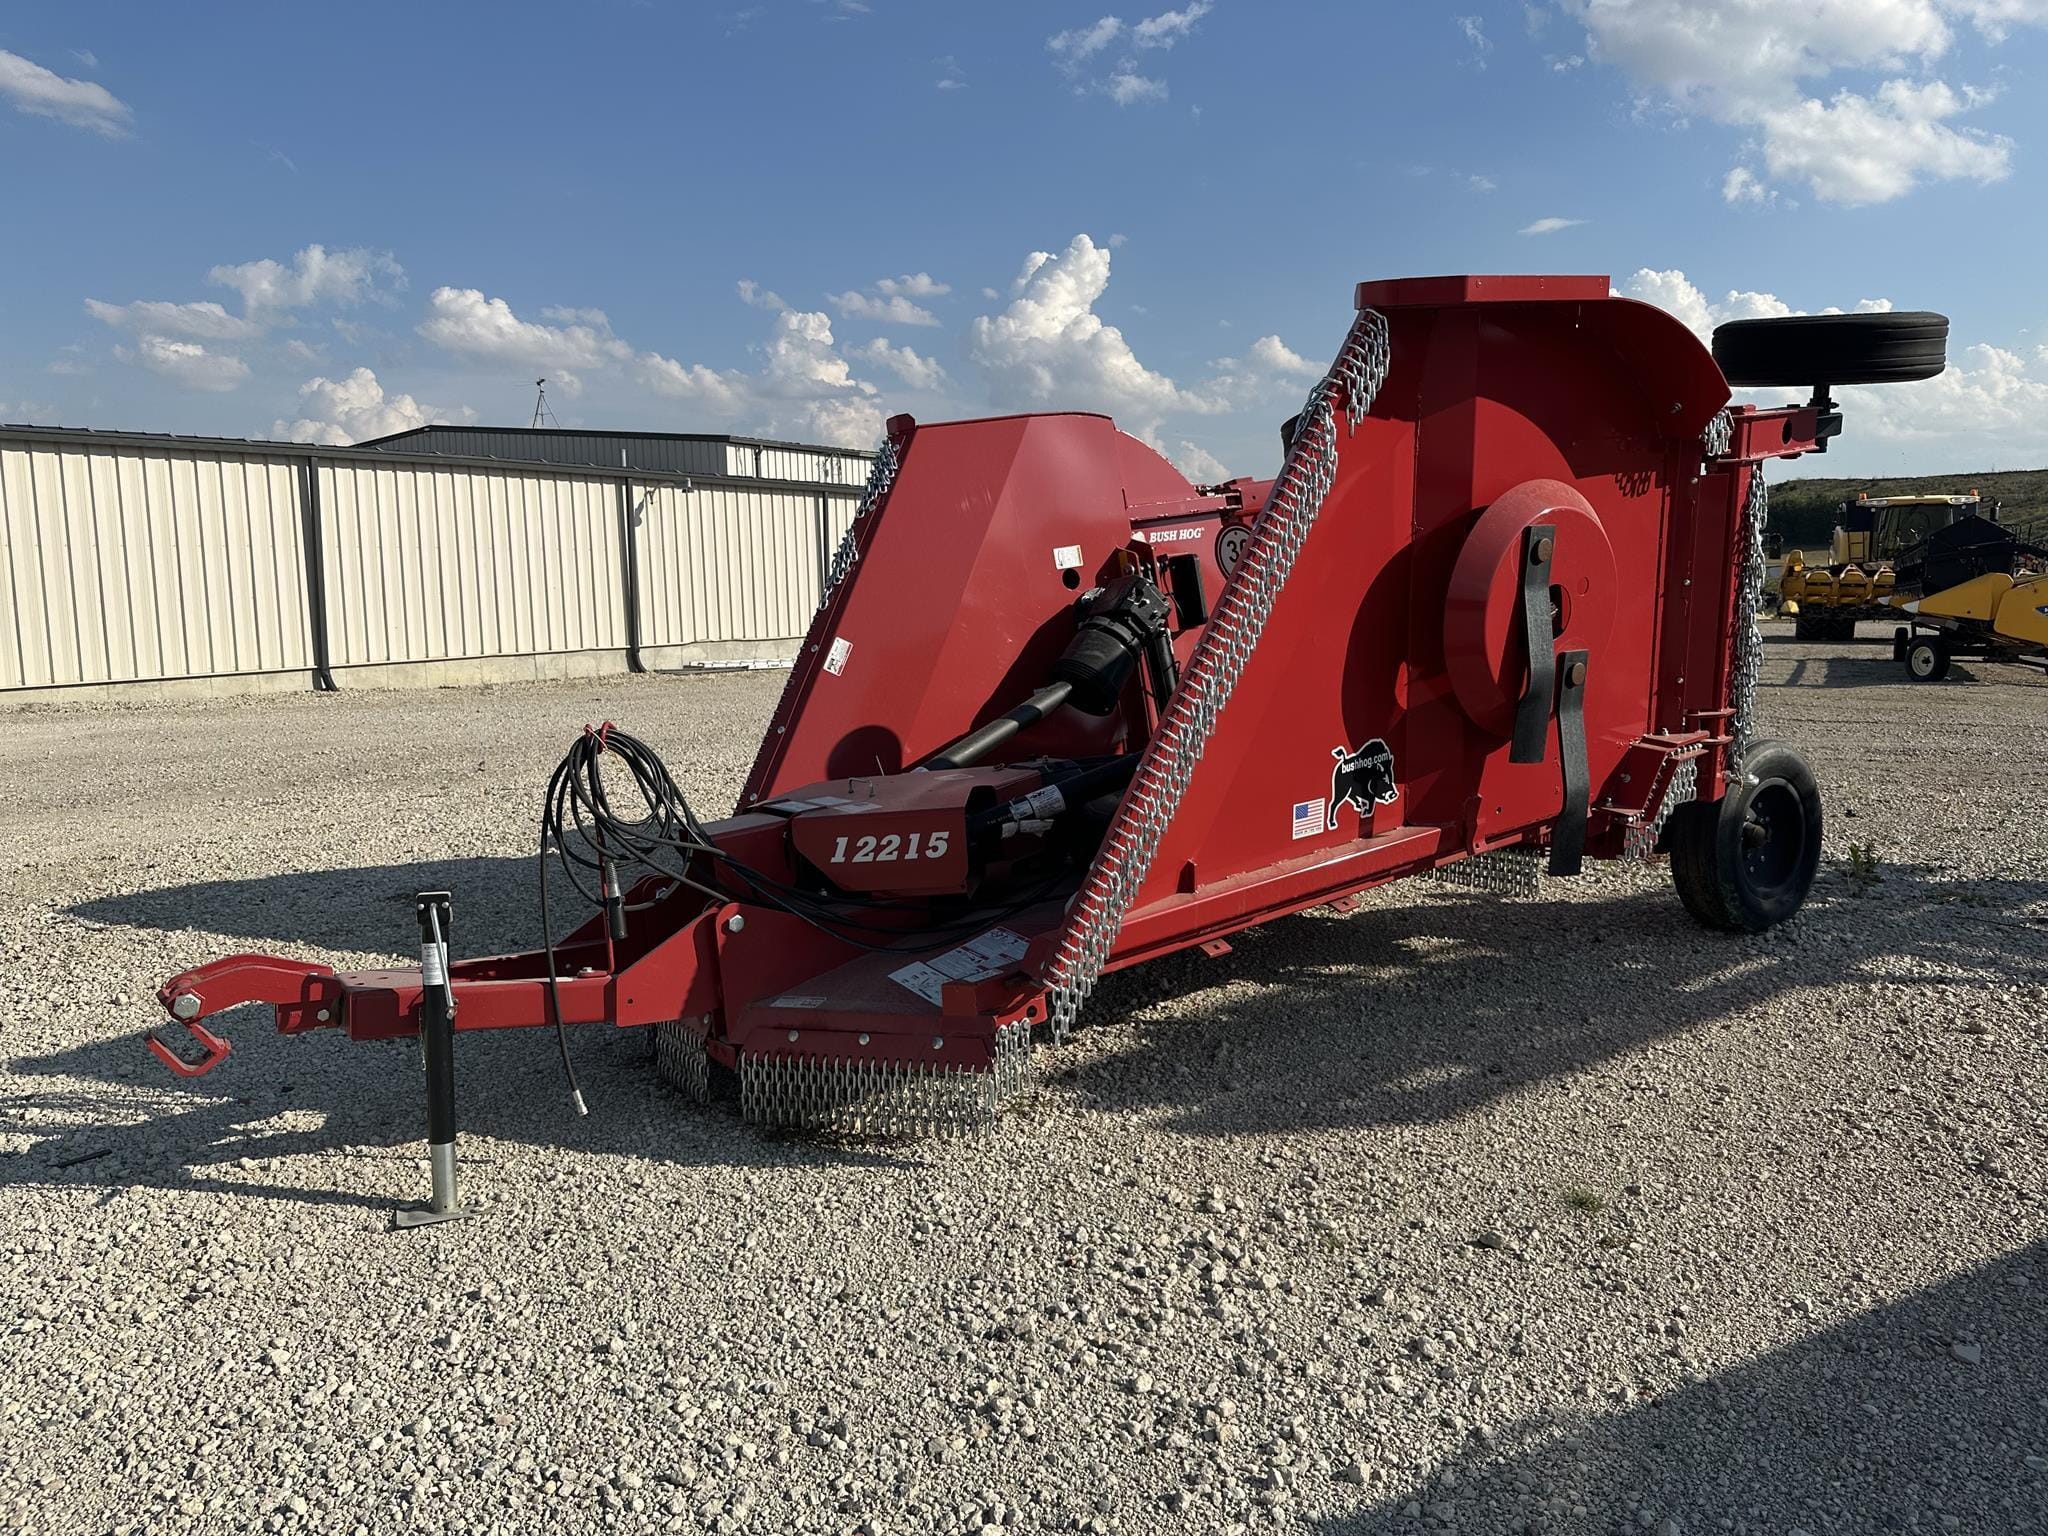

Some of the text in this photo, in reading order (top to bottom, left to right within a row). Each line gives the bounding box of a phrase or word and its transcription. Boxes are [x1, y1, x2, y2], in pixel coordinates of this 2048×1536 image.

[1149, 528, 1202, 543] BUSH HOG
[1341, 753, 1389, 774] bushhog.com
[830, 831, 950, 863] 12215
